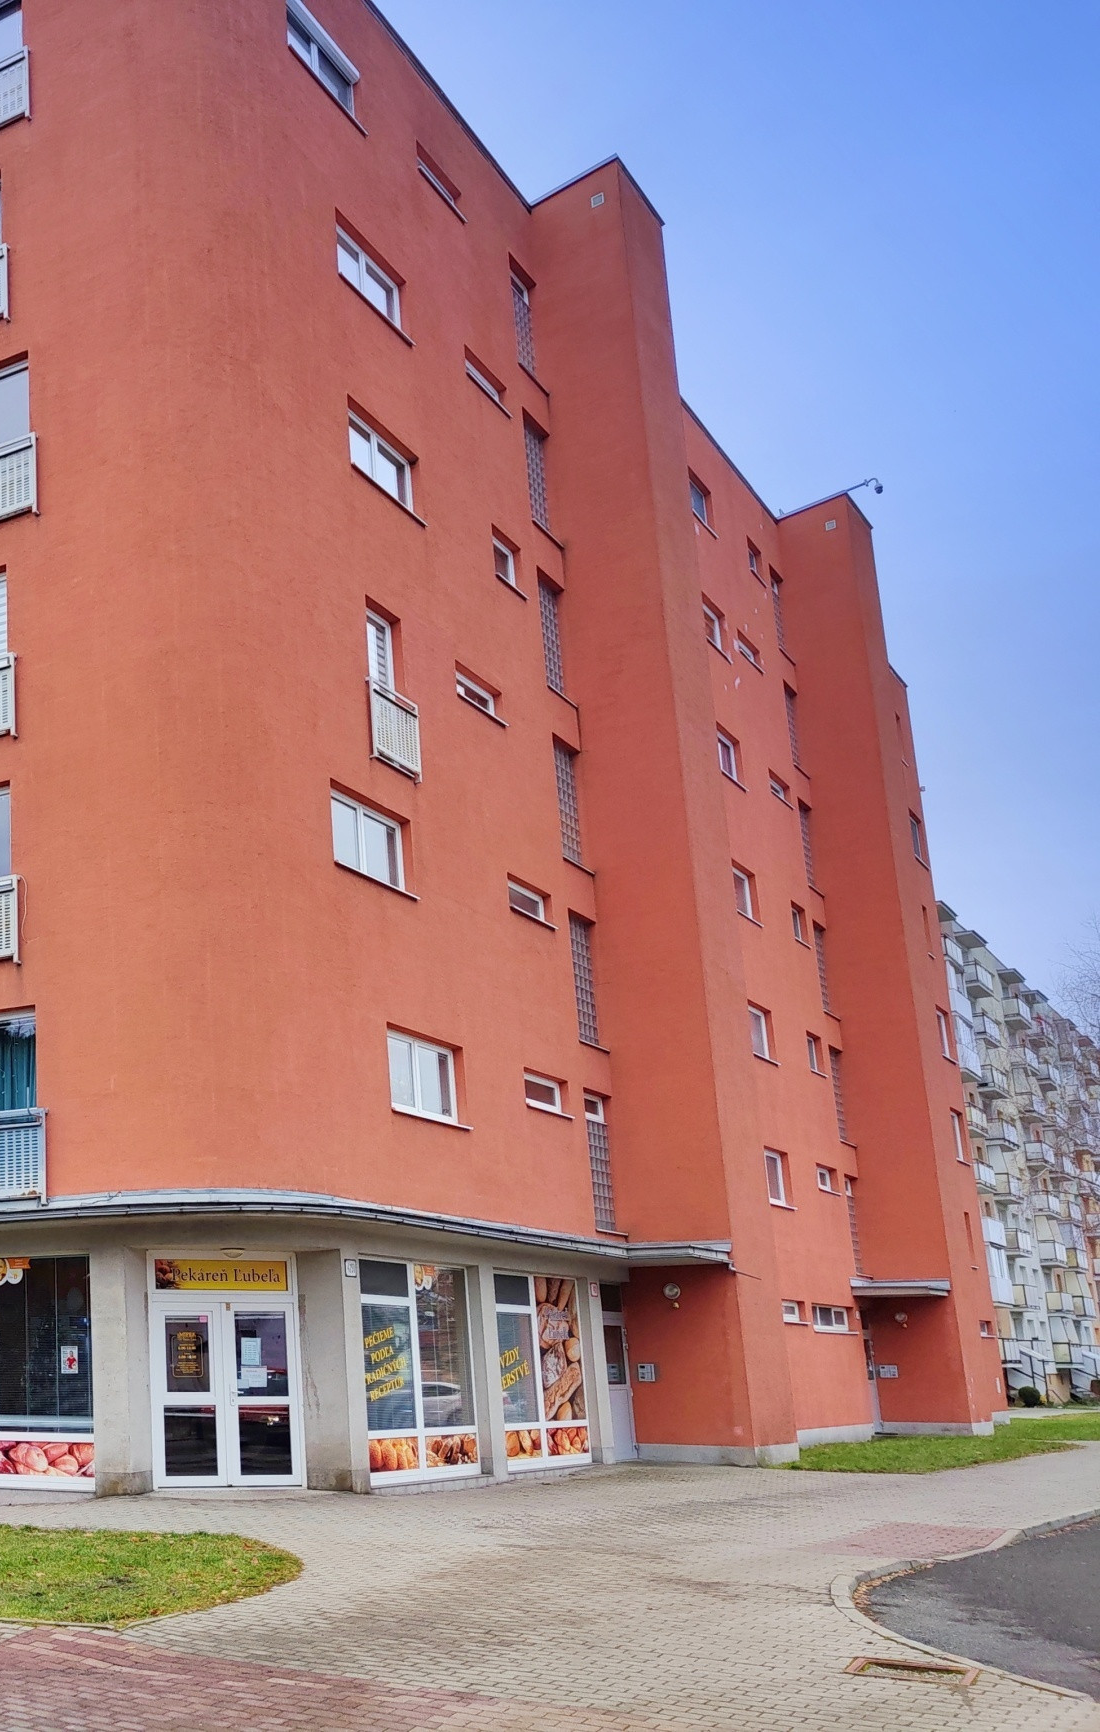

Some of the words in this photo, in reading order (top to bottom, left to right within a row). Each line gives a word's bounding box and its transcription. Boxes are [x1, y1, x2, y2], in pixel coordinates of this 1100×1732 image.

[171, 1267, 228, 1282] Pekáreň
[233, 1268, 280, 1283] Ľubeľa
[364, 1327, 395, 1349] PEČIEME
[501, 1360, 530, 1390] ERSTVÉ
